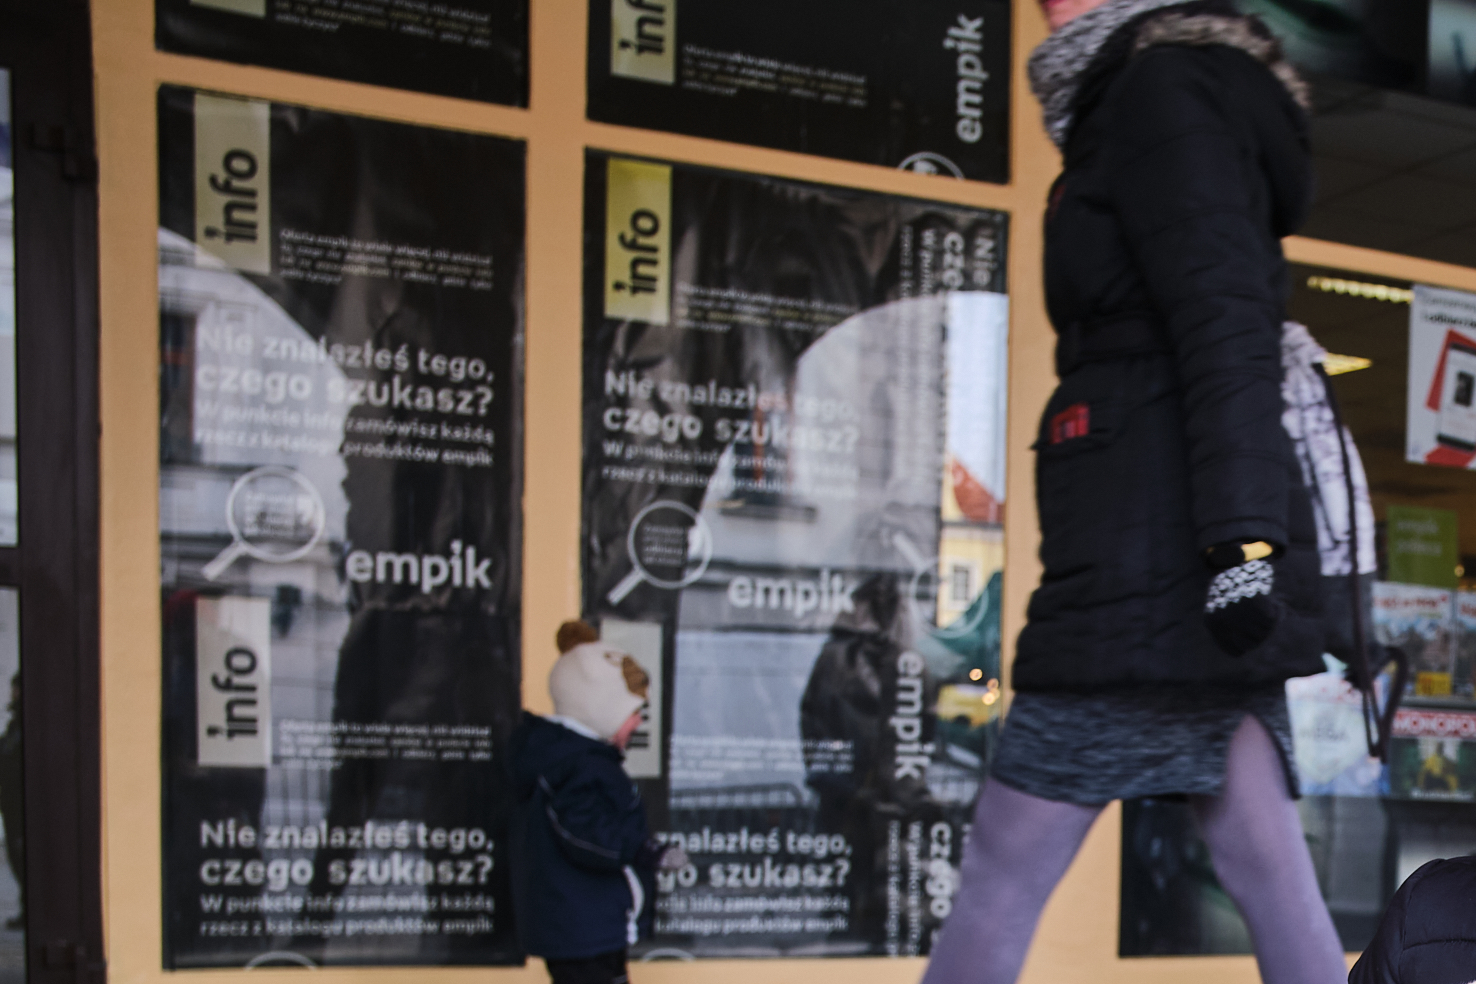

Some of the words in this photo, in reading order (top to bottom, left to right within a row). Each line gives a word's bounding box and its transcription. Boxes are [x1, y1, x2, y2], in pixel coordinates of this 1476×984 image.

[945, 14, 989, 143] empik
[206, 148, 258, 243] info
[614, 209, 660, 296] info
[199, 364, 312, 404] czego
[327, 374, 494, 416] szukasz?
[417, 350, 494, 383] tego,
[604, 370, 654, 399] Nie
[603, 408, 703, 443] czego
[345, 540, 493, 593] empik
[728, 567, 857, 617] empik
[208, 647, 258, 740] info
[889, 653, 934, 780] empik
[201, 818, 255, 848] Nie
[264, 819, 410, 849] znalazłeś
[416, 822, 494, 854] tego,
[786, 828, 852, 858] tego,
[201, 859, 314, 892] czego
[327, 853, 494, 885] szukasz?
[709, 856, 851, 888] szukasz?
